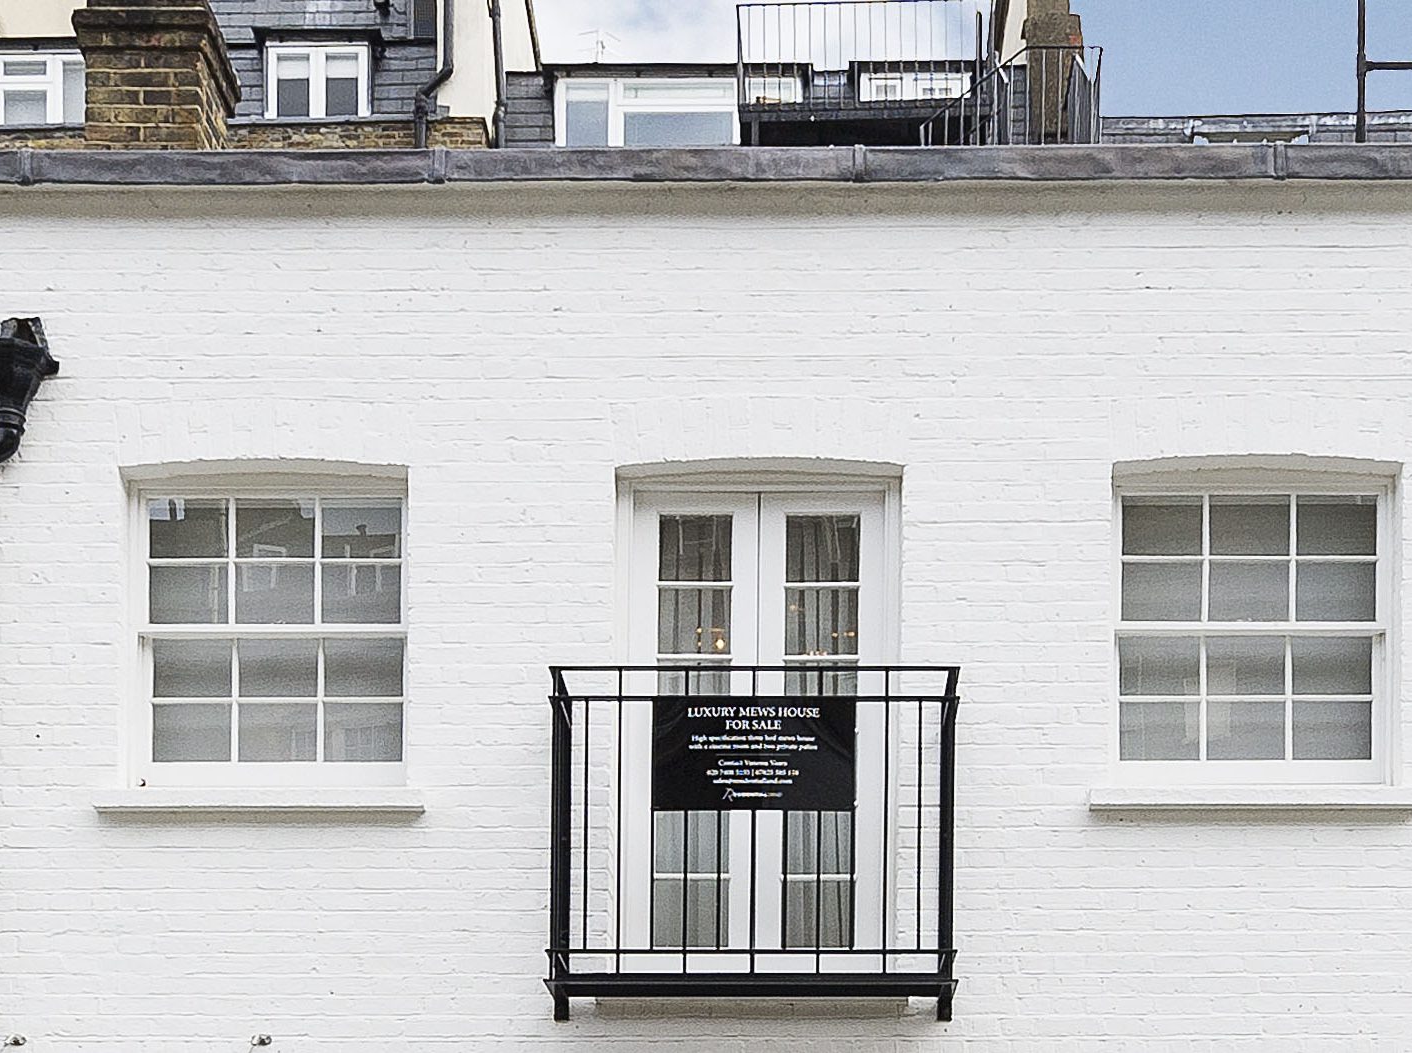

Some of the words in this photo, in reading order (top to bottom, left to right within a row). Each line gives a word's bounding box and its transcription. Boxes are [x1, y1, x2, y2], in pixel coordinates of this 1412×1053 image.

[688, 707, 737, 717] LUXURY
[739, 707, 776, 717] MEWS
[778, 707, 820, 718] HOUSE
[725, 720, 750, 730] FOR
[752, 720, 782, 730] SALE
